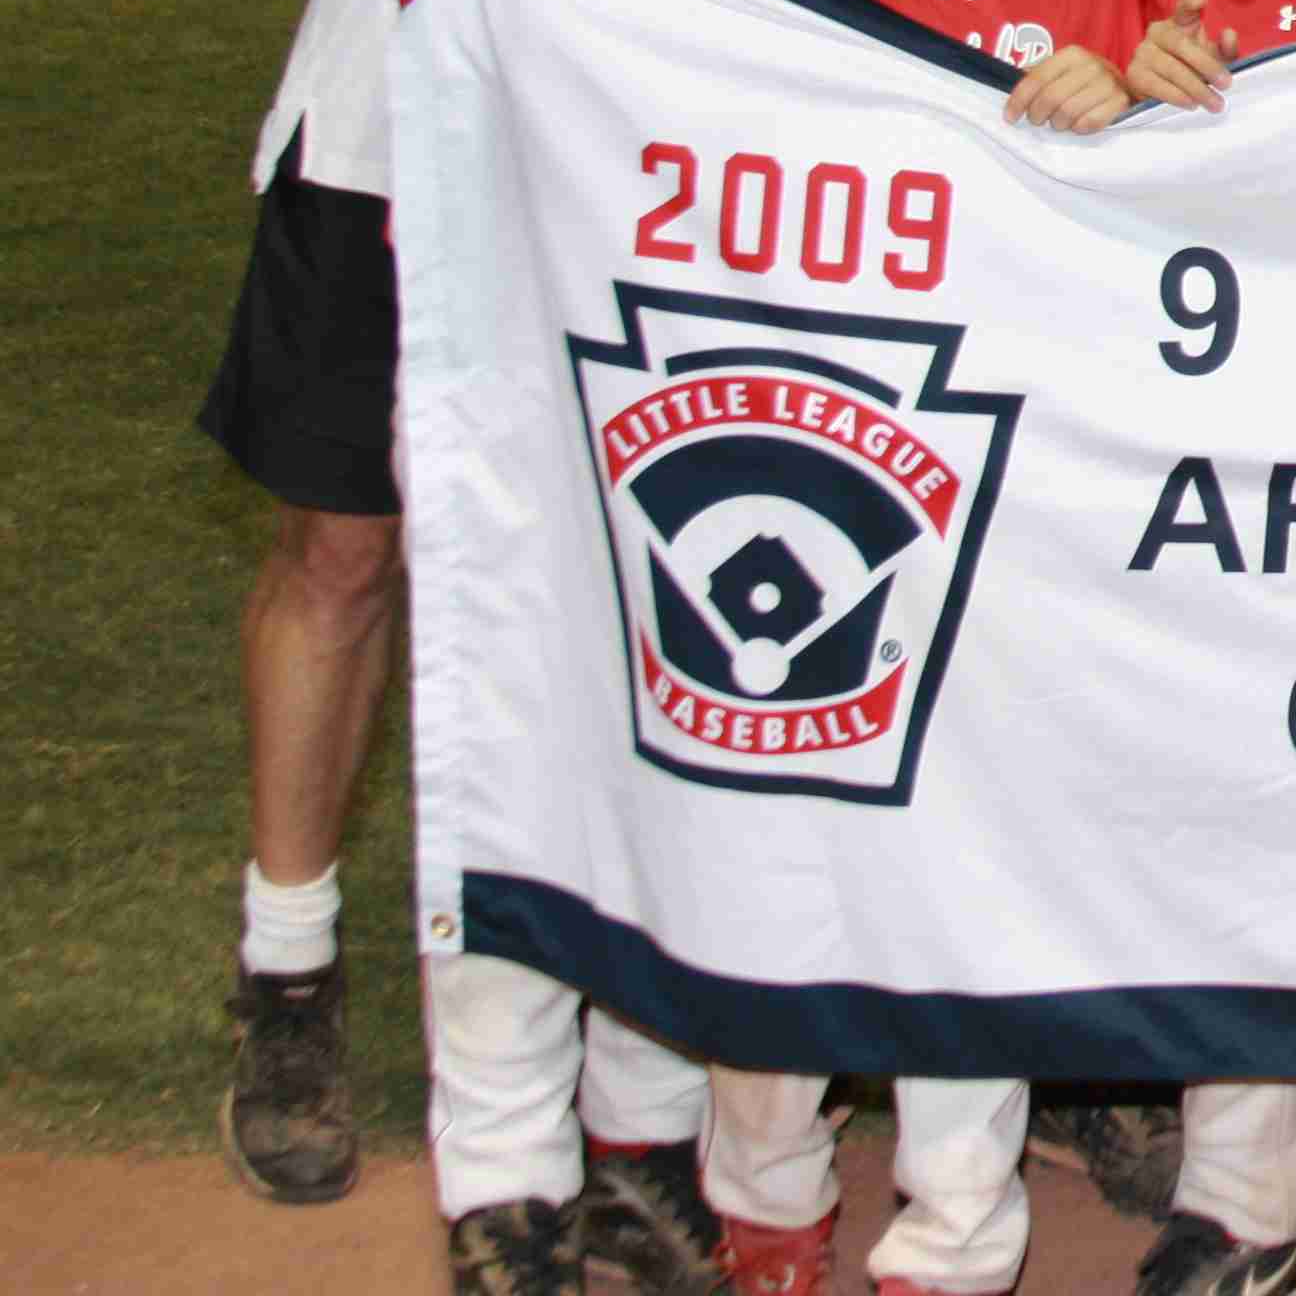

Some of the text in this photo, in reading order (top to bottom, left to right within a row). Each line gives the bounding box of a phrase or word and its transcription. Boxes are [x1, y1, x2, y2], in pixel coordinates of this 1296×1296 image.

[634, 141, 953, 292] 2009
[1158, 246, 1241, 376] 9
[606, 381, 950, 502] LITTLE LEAGUE
[652, 673, 880, 751] BASEBALL
